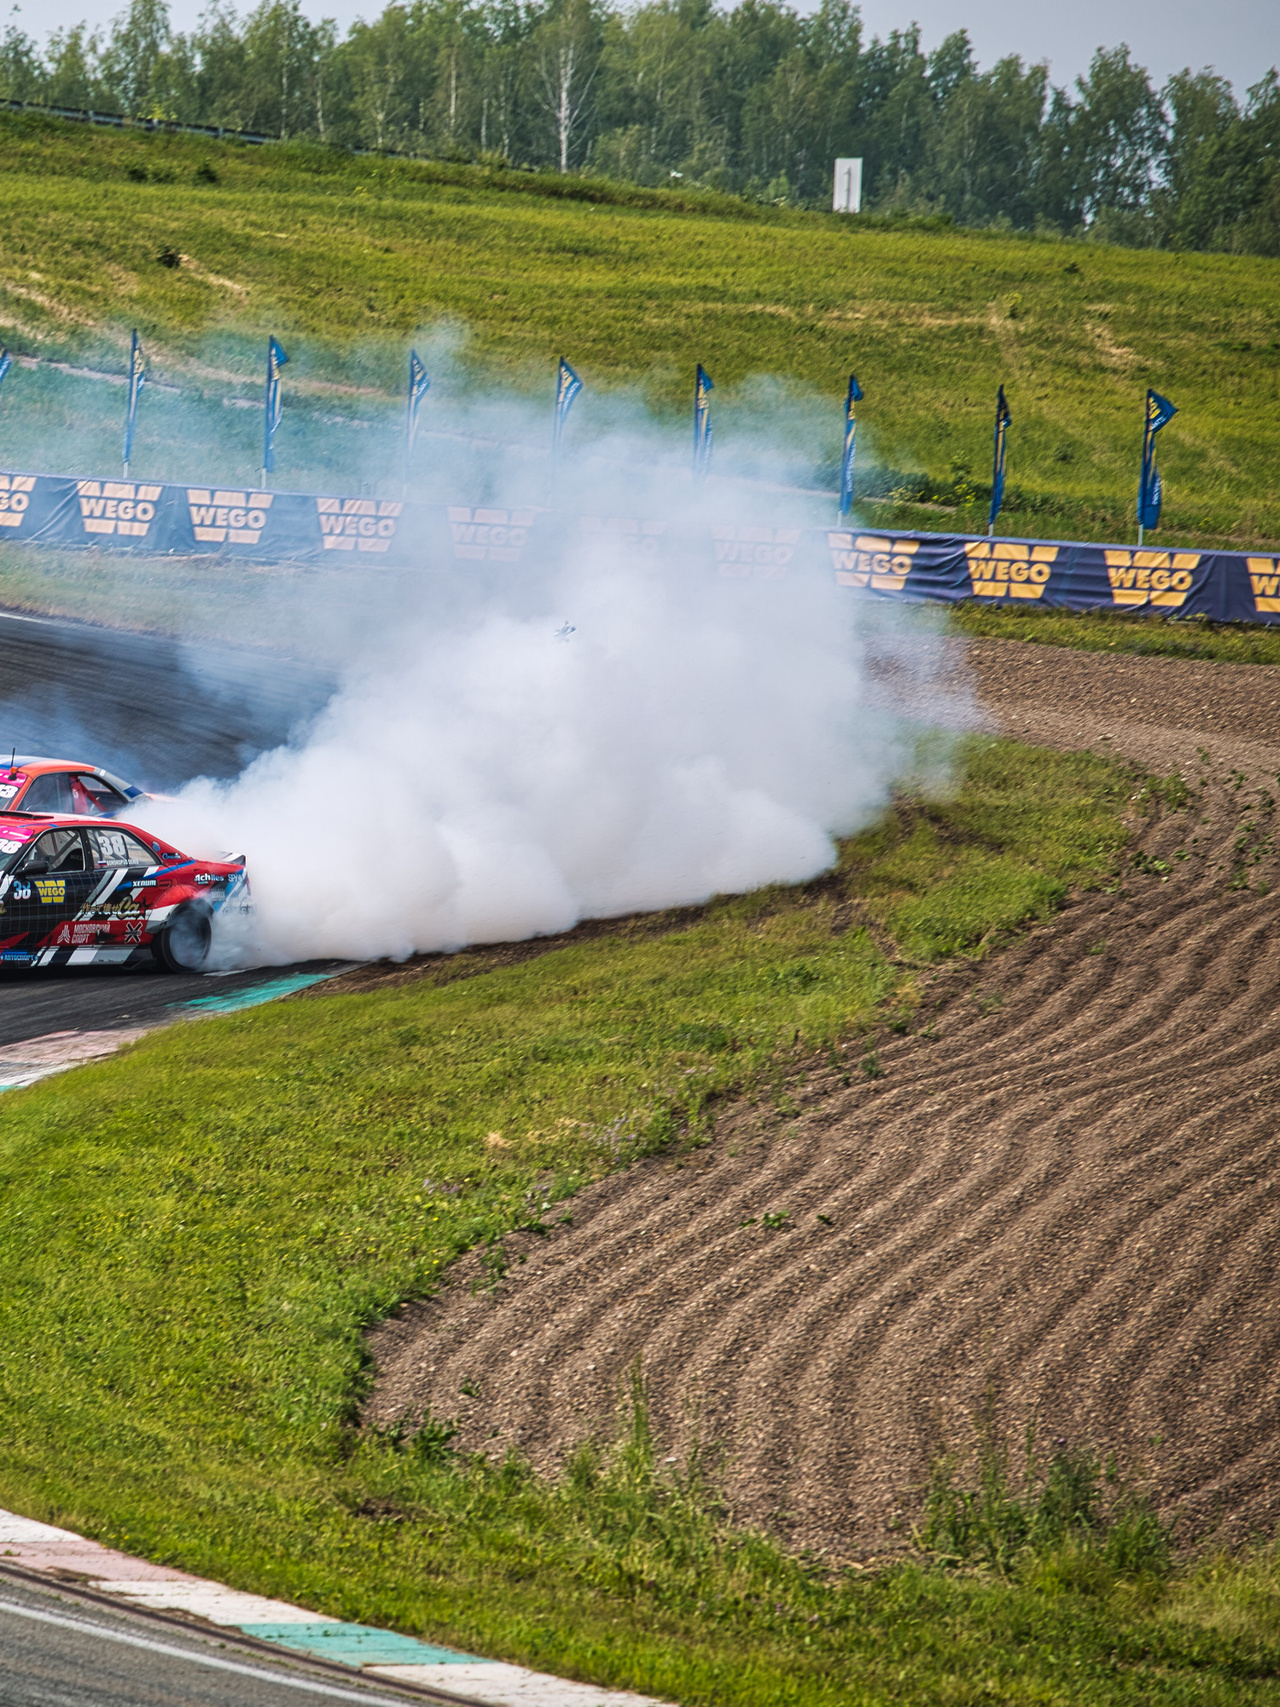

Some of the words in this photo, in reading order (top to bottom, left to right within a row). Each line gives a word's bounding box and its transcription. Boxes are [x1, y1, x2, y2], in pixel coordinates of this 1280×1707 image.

[80, 498, 155, 522] WEGO
[192, 506, 266, 530] WEGO
[320, 514, 394, 538] WEGO
[833, 551, 912, 574] WEGO
[968, 560, 1051, 584] WEGO
[1111, 568, 1193, 591] WEGO
[98, 835, 127, 856] 38
[13, 880, 31, 900] 38
[38, 887, 66, 896] WEGO
[71, 934, 90, 944] СПОРТ
